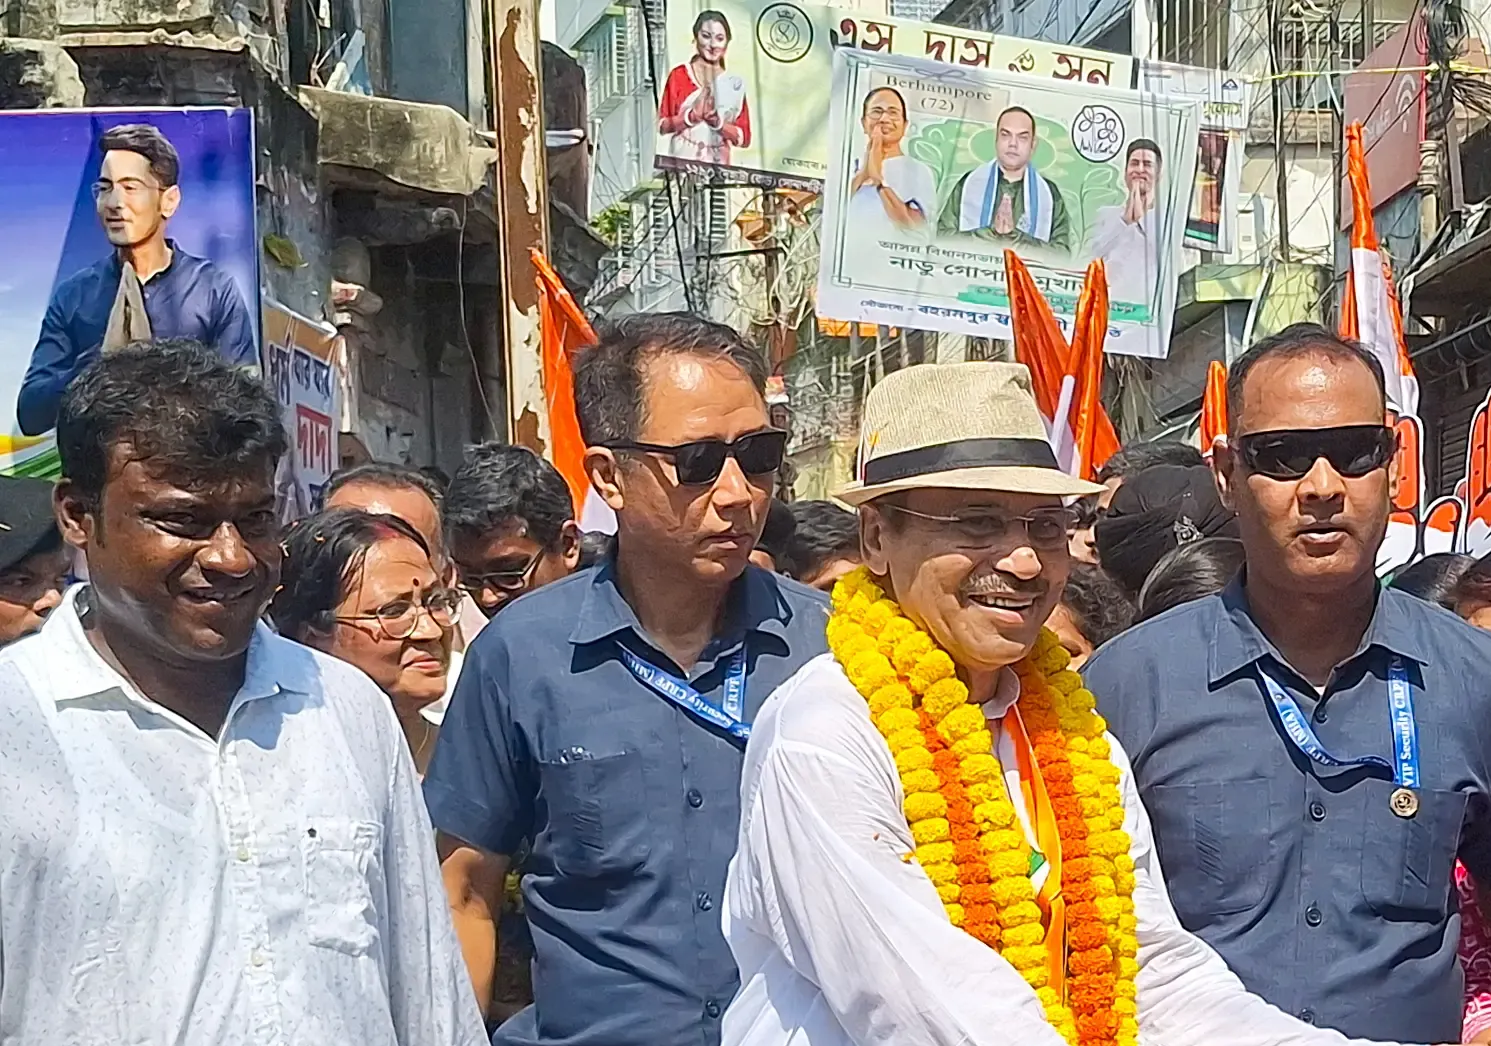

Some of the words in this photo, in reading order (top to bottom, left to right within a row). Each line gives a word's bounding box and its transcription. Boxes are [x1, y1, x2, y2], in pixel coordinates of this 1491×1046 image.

[923, 30, 994, 68] দাস
[885, 75, 992, 101] Berhampore
[921, 97, 954, 113] (72)
[943, 263, 1005, 282] গোপা
[917, 305, 989, 324] বহরমপুর
[296, 403, 332, 475] দাদা
[655, 676, 687, 701] CRPF
[1281, 709, 1309, 748] (MHA)
[1397, 710, 1412, 760] Security
[1402, 764, 1415, 786] VIP
